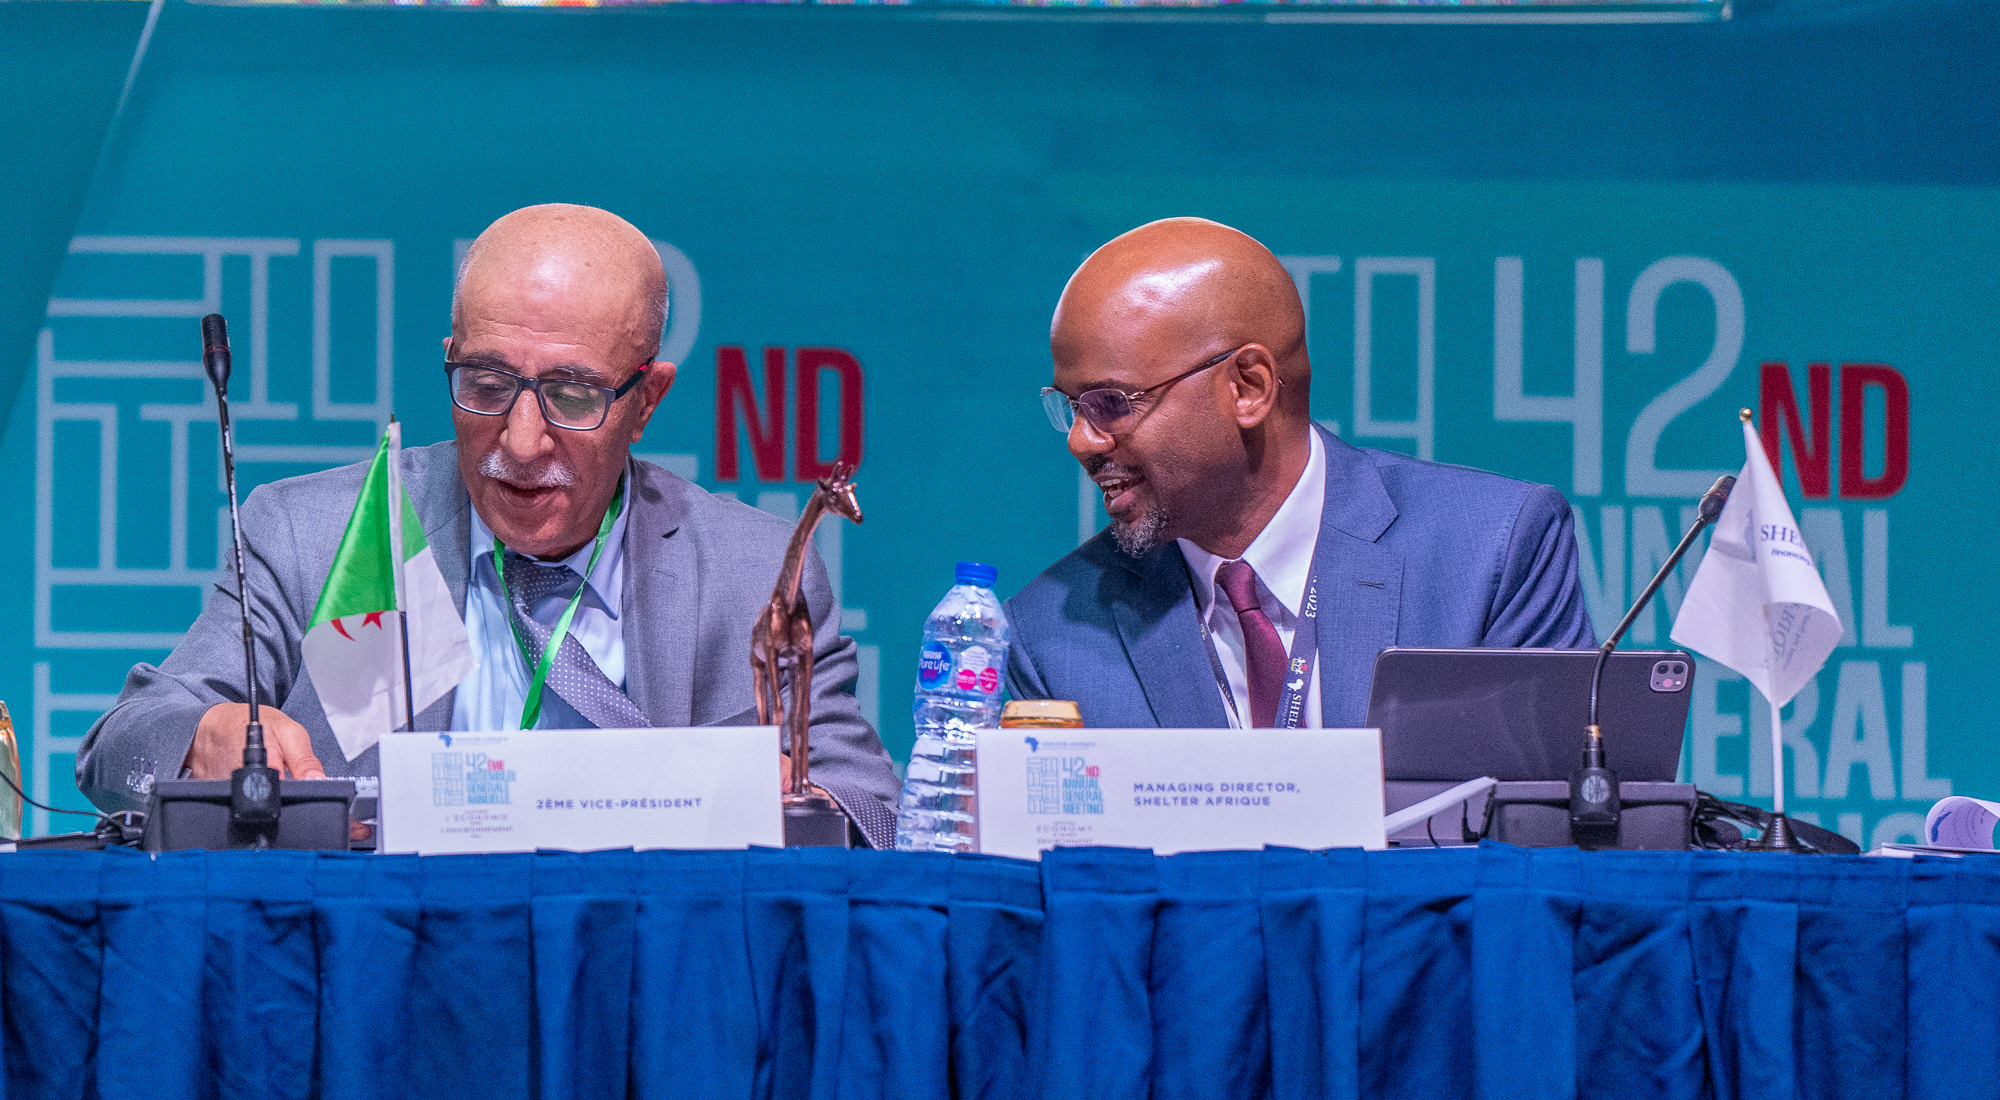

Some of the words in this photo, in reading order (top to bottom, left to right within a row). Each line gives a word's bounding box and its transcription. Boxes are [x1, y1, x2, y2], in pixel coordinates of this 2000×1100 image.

[1760, 523, 1804, 550] SHE
[1305, 586, 1318, 619] 2023
[934, 660, 951, 674] Life
[1063, 778, 1098, 790] ANNUAL
[1133, 782, 1214, 792] MANAGING
[1220, 782, 1300, 793] DIRECTOR,
[579, 796, 702, 809] VICE-PRÉSIDENT
[1062, 790, 1102, 802] GENERAL
[1134, 796, 1199, 807] SHELTER
[1205, 796, 1271, 807] AFRIQUE
[1062, 802, 1104, 815] MEETING
